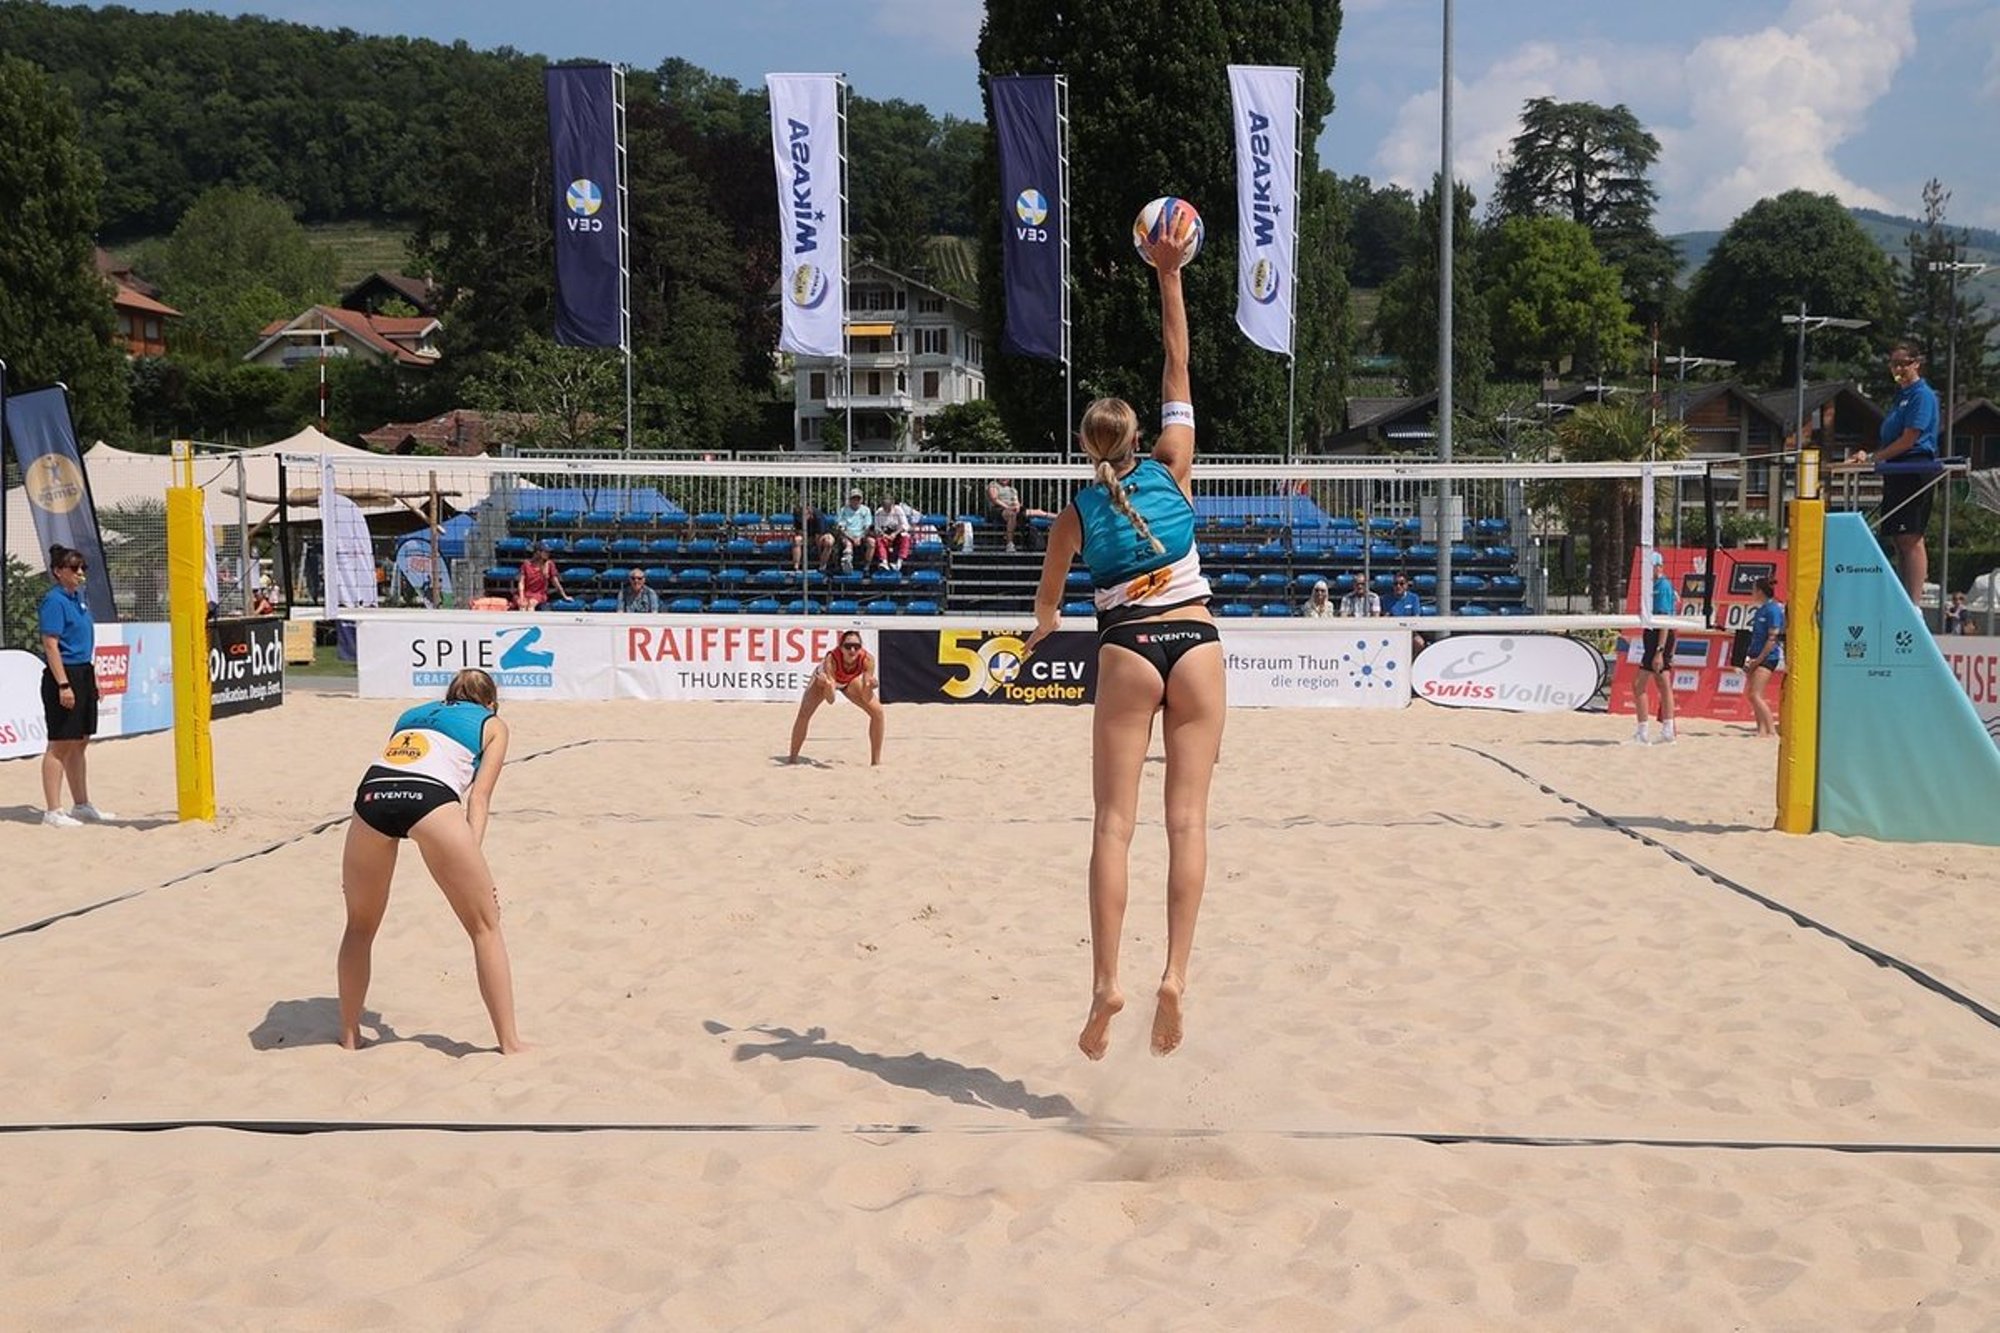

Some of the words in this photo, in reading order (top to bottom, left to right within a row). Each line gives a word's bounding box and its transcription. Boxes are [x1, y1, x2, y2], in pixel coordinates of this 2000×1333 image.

[1846, 565, 1883, 574] Senoh
[1150, 631, 1202, 643] EVENTUS
[1032, 661, 1086, 681] CEV
[1298, 655, 1339, 671] Thun
[502, 674, 550, 686] WASSER
[678, 671, 798, 690] THUNERSEE
[1271, 674, 1292, 688] die
[1298, 675, 1339, 690] region
[1003, 683, 1086, 703] Together
[374, 790, 424, 801] EVENTUS
